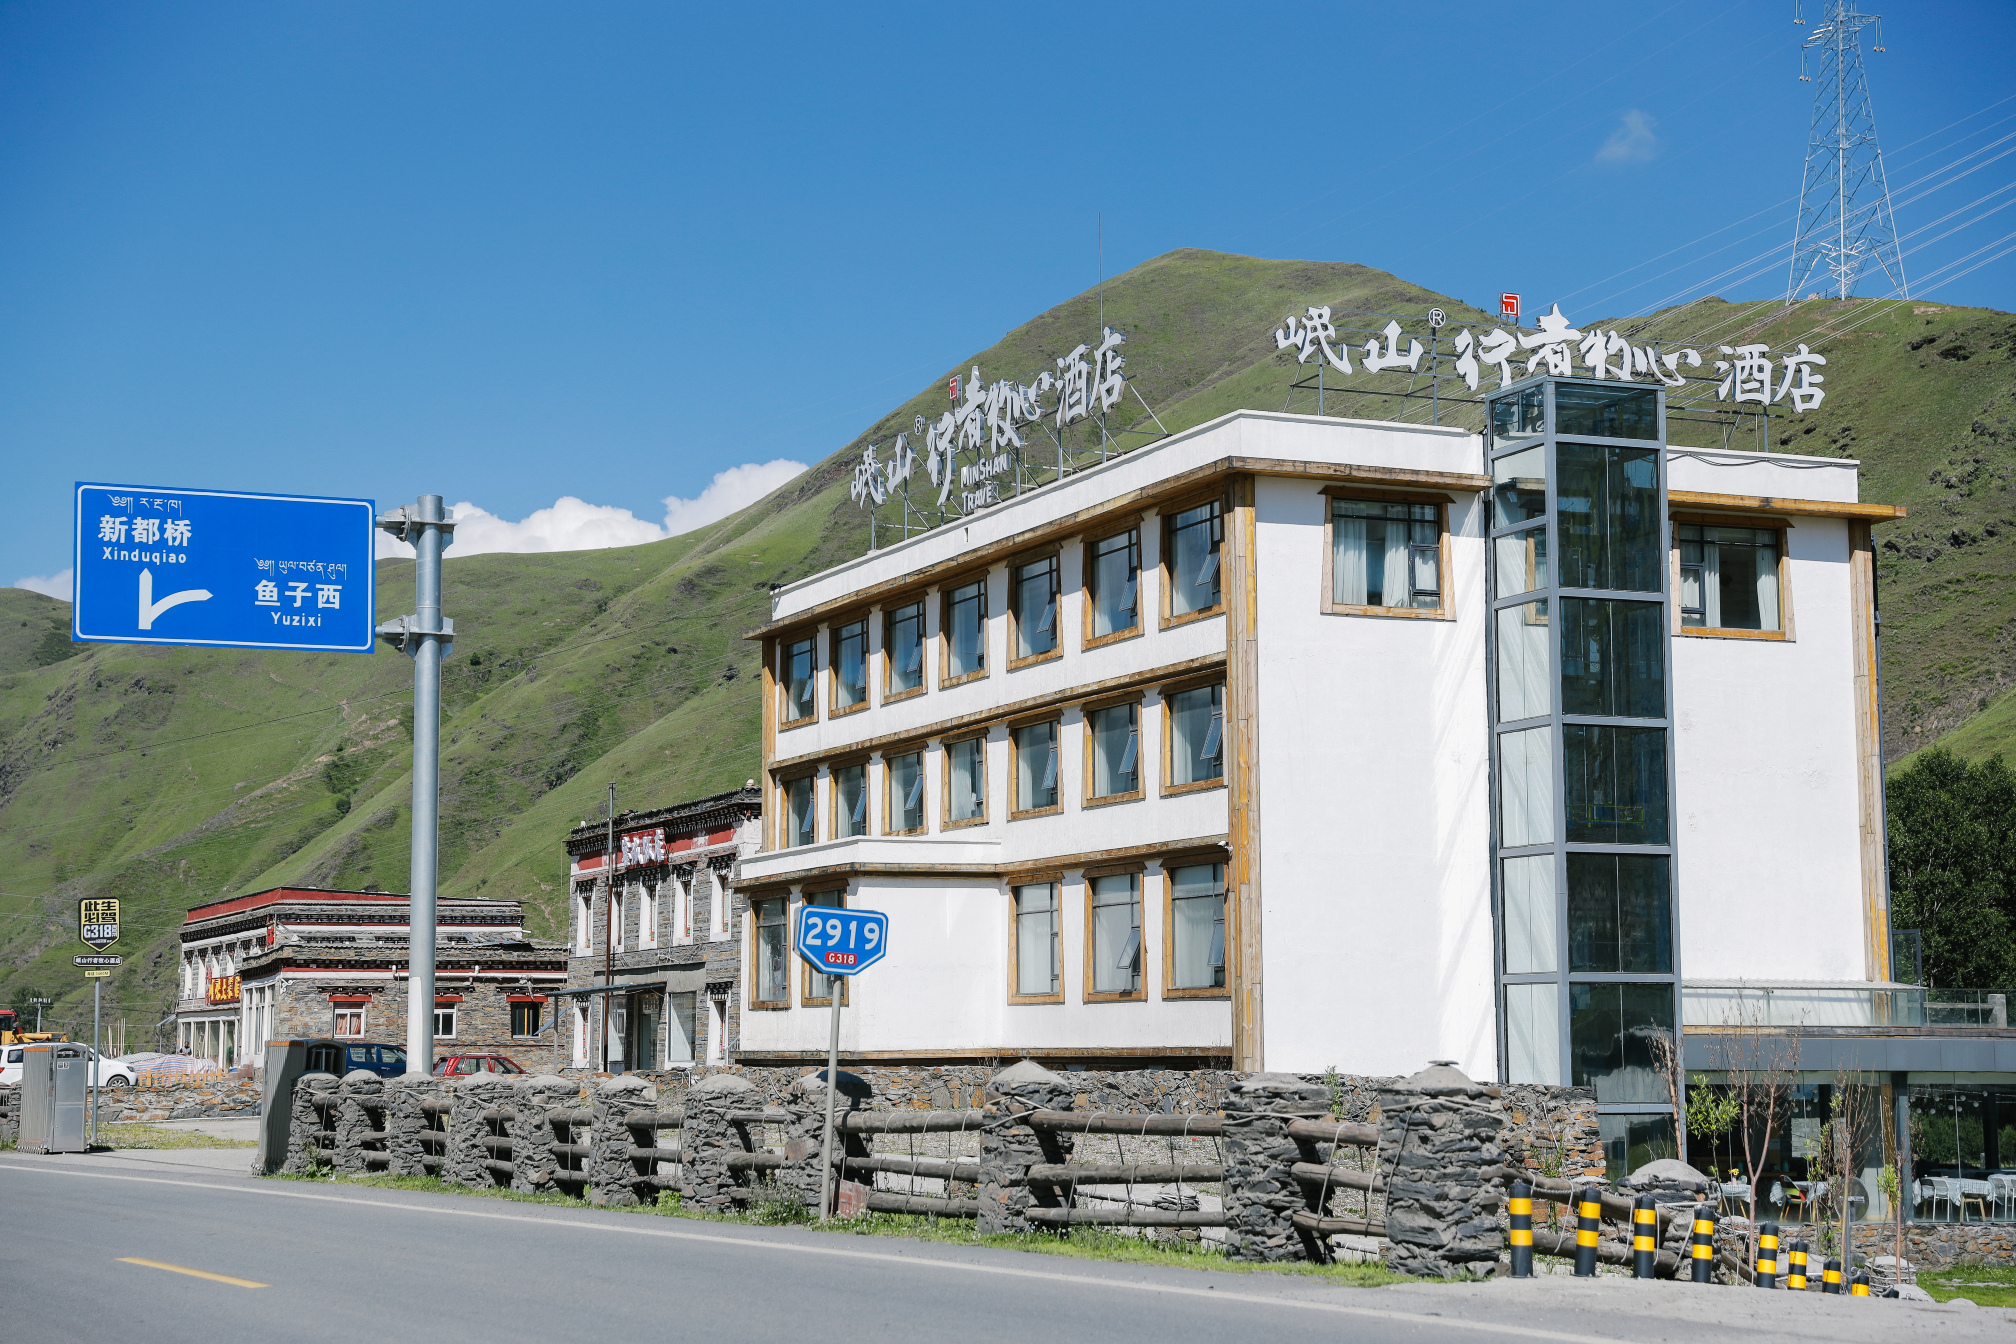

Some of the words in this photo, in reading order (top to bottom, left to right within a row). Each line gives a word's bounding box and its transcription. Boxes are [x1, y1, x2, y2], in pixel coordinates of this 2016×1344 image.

[961, 453, 1009, 488] MINSHAN
[98, 515, 192, 547] 新都桥
[102, 546, 187, 566] Xinduqiao
[254, 579, 343, 609] 鱼子西
[271, 612, 321, 627] Yuzixi
[84, 901, 117, 911] 此生
[84, 912, 117, 923] 必驾
[83, 924, 112, 938] G318
[805, 916, 880, 950] 2919
[828, 953, 855, 964] G318
